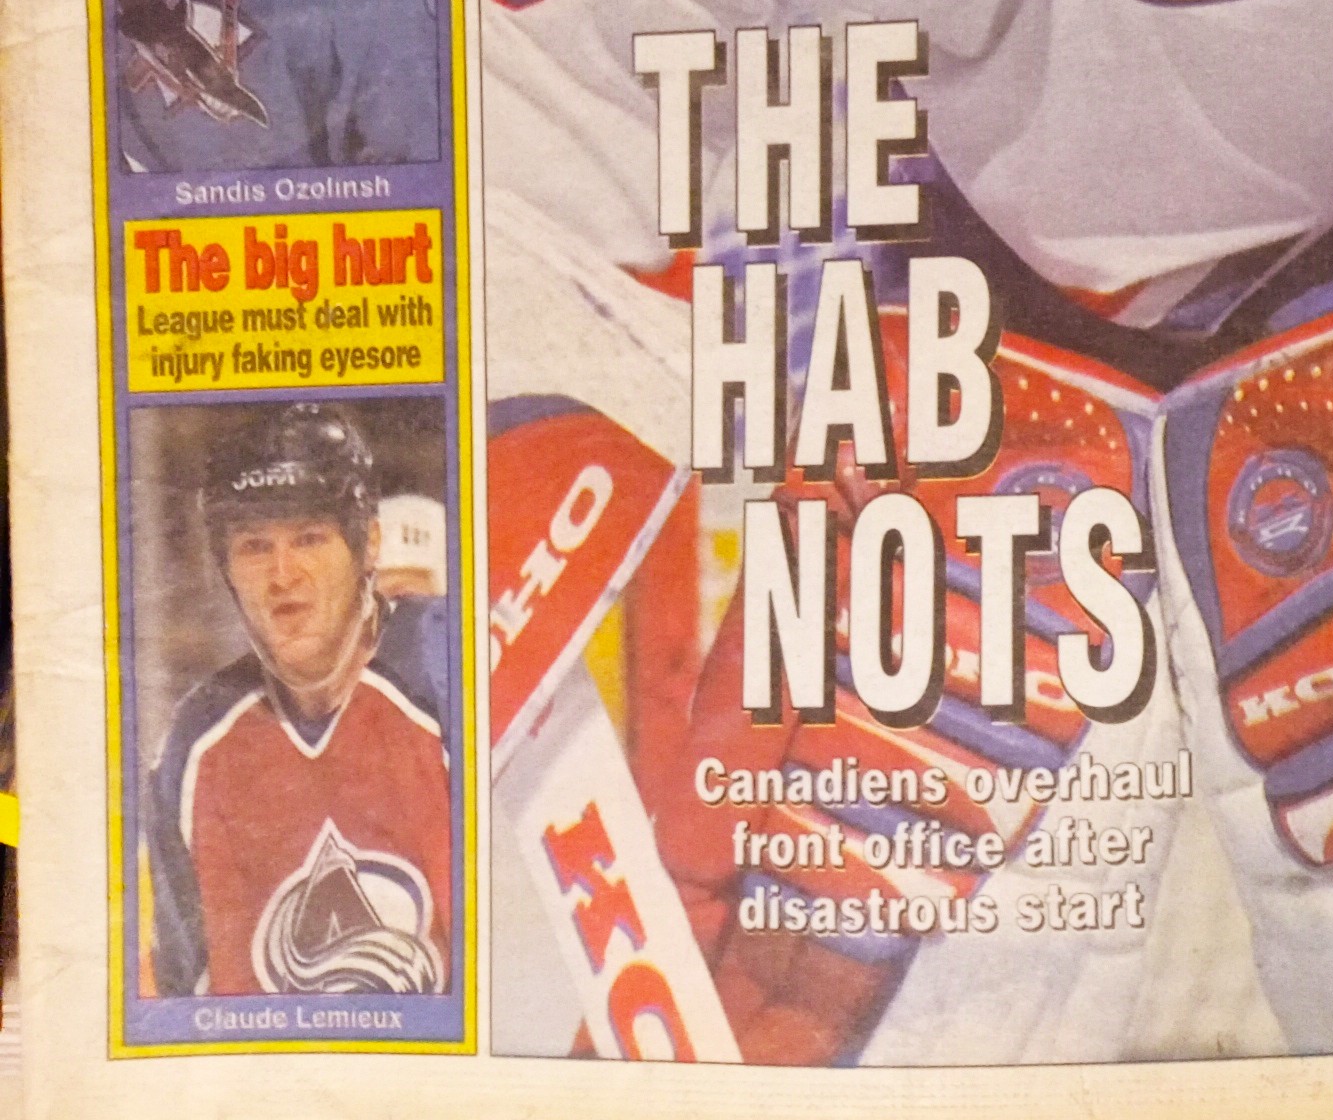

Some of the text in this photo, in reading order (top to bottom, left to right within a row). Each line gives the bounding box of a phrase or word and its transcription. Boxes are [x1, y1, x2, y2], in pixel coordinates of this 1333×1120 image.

[632, 19, 929, 249] THE
[175, 174, 392, 206] Sandis Ozolinsh
[134, 221, 433, 302] The big hurt
[137, 293, 433, 339] League must deal with
[151, 342, 421, 382] injury faking eyesore
[691, 255, 1003, 484] HAB
[742, 485, 1157, 730] NOTS
[695, 749, 1194, 805] Canadiens overhaul
[732, 816, 1155, 870] front office after
[738, 881, 1147, 933] disastrous start
[194, 1004, 403, 1032] Claude Lemieux
